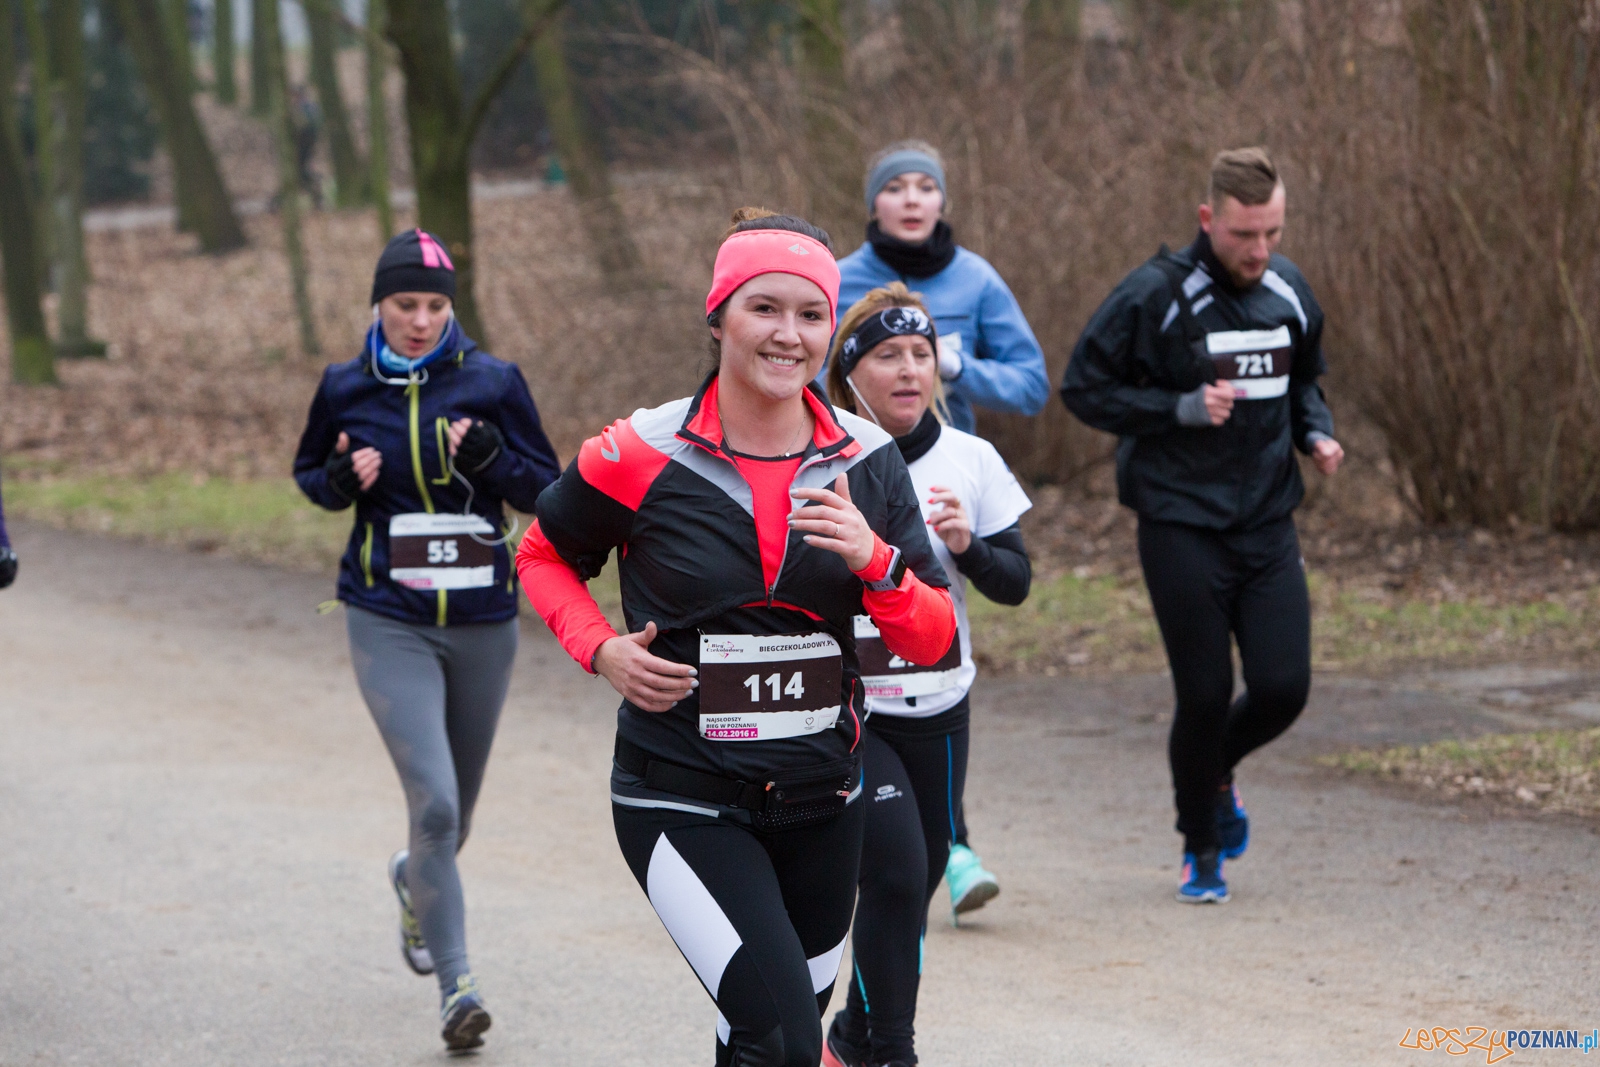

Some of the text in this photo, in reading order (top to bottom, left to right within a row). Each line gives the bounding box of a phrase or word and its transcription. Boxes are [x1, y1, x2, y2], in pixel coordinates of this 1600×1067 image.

[1235, 353, 1273, 376] 721
[427, 539, 459, 563] 55
[759, 640, 835, 653] BIEGCZEKOLADOWY.PL
[743, 671, 805, 702] 114
[707, 730, 749, 738] 14.02.2016
